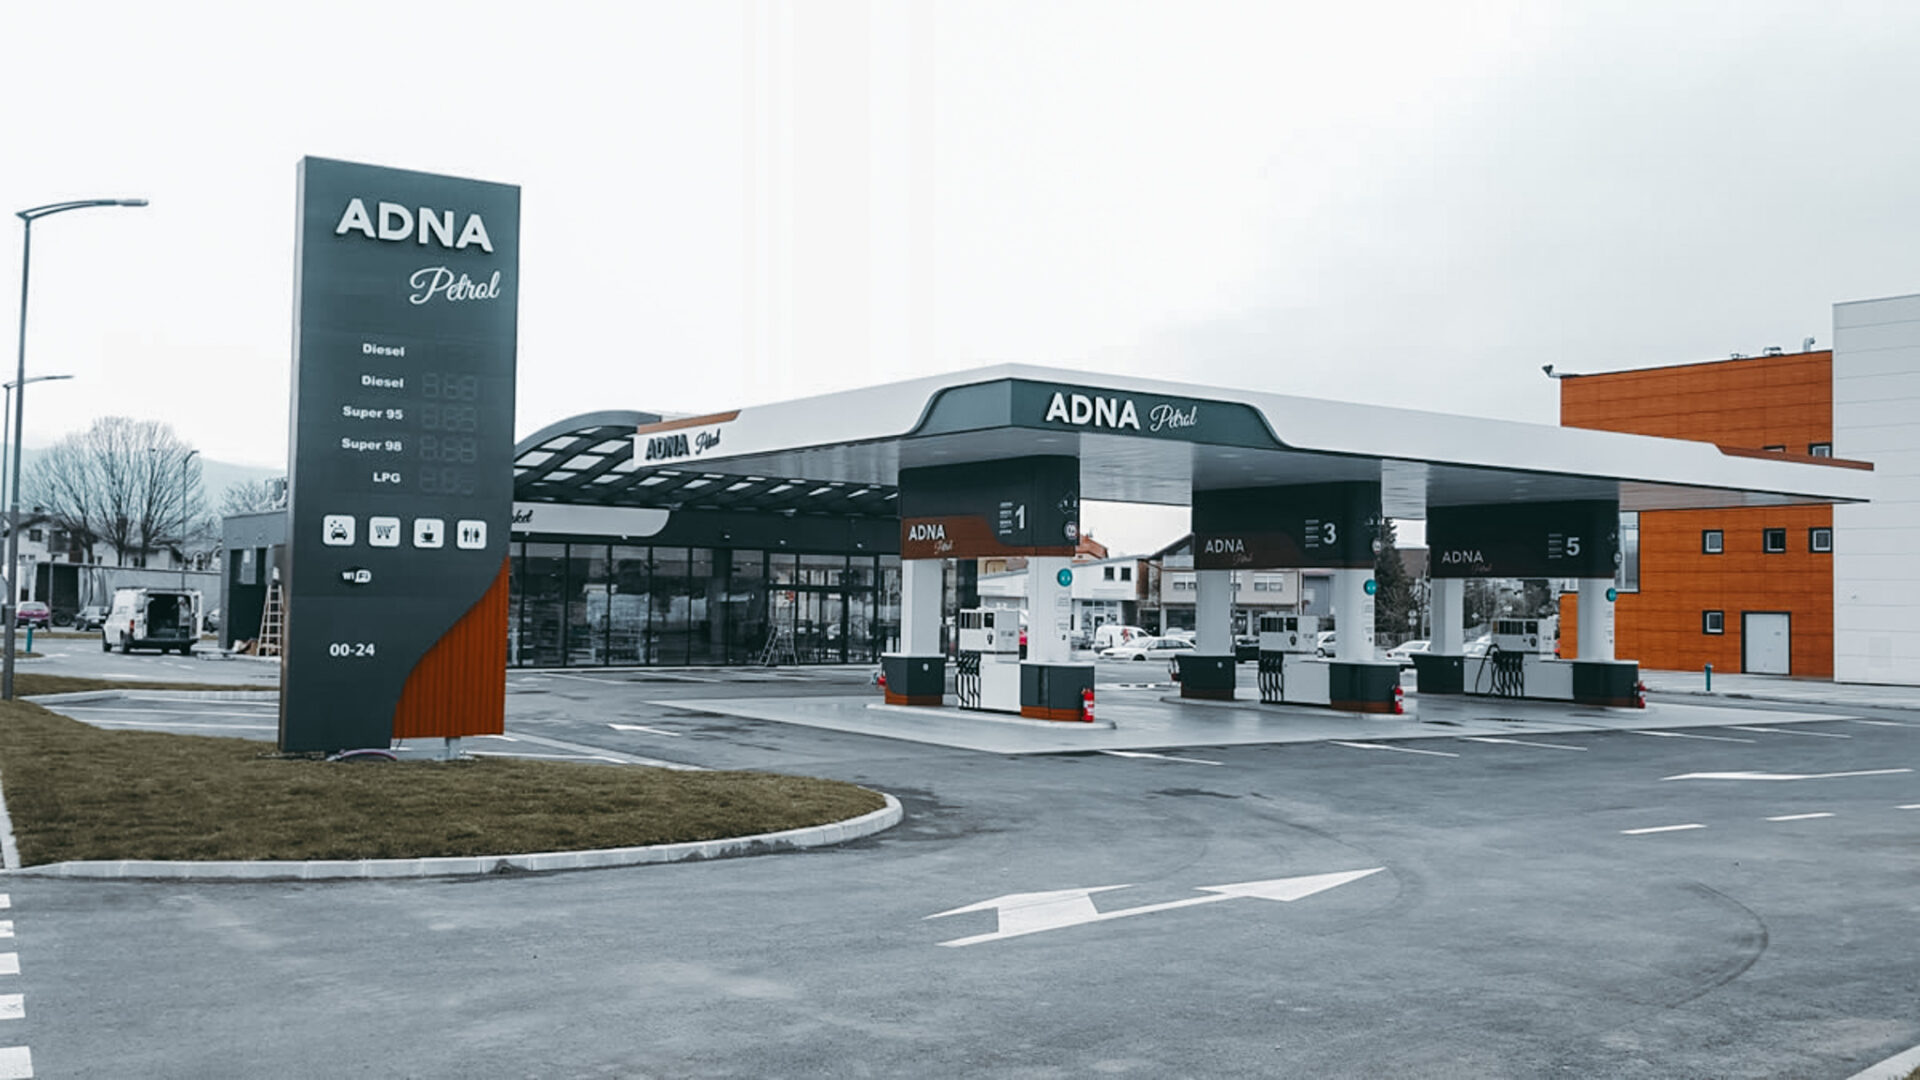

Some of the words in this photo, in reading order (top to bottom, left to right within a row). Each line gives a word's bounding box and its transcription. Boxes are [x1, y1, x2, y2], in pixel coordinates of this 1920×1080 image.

[335, 198, 494, 253] ADNA
[409, 266, 501, 305] Petrol
[362, 343, 405, 357] Diesel
[361, 375, 404, 389] Diesel
[342, 405, 383, 419] Super
[386, 408, 404, 420] 95
[1046, 392, 1141, 430] ADNA
[1150, 404, 1198, 432] Petrol
[341, 437, 382, 452] Super
[385, 441, 402, 452] 98
[645, 433, 690, 460] ADNA
[373, 472, 401, 484] LPG
[1015, 504, 1025, 530] 1
[908, 523, 946, 541] ADNA
[1323, 522, 1337, 545] 3
[1204, 538, 1245, 554] ADNA
[1565, 536, 1581, 556] 5
[1440, 550, 1484, 564] ADNA
[329, 643, 376, 657] 00-24
